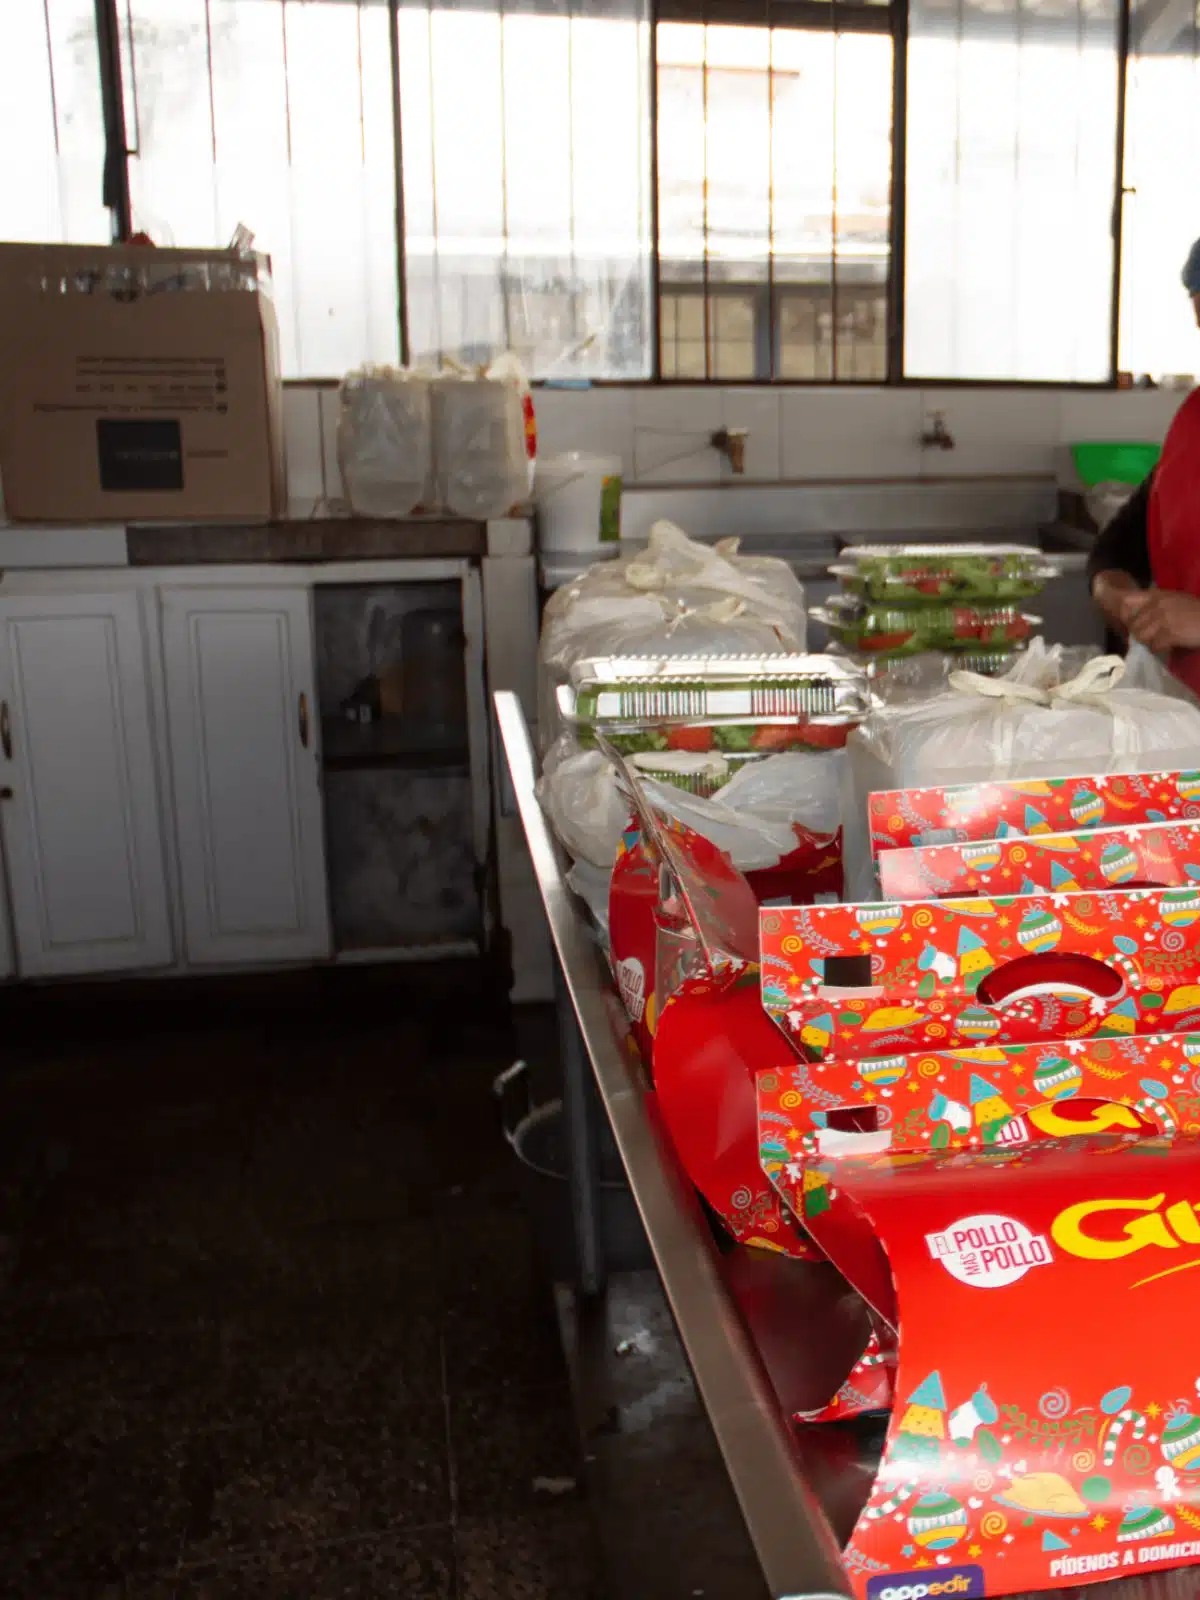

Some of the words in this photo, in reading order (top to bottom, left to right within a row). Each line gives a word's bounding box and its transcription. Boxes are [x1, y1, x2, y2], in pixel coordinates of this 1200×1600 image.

[934, 1235, 956, 1255] EL
[953, 1222, 1018, 1252] POLLO
[981, 1240, 1046, 1273] POLLO
[1050, 1551, 1119, 1578] PÍDENOS
[1122, 1547, 1135, 1566] A
